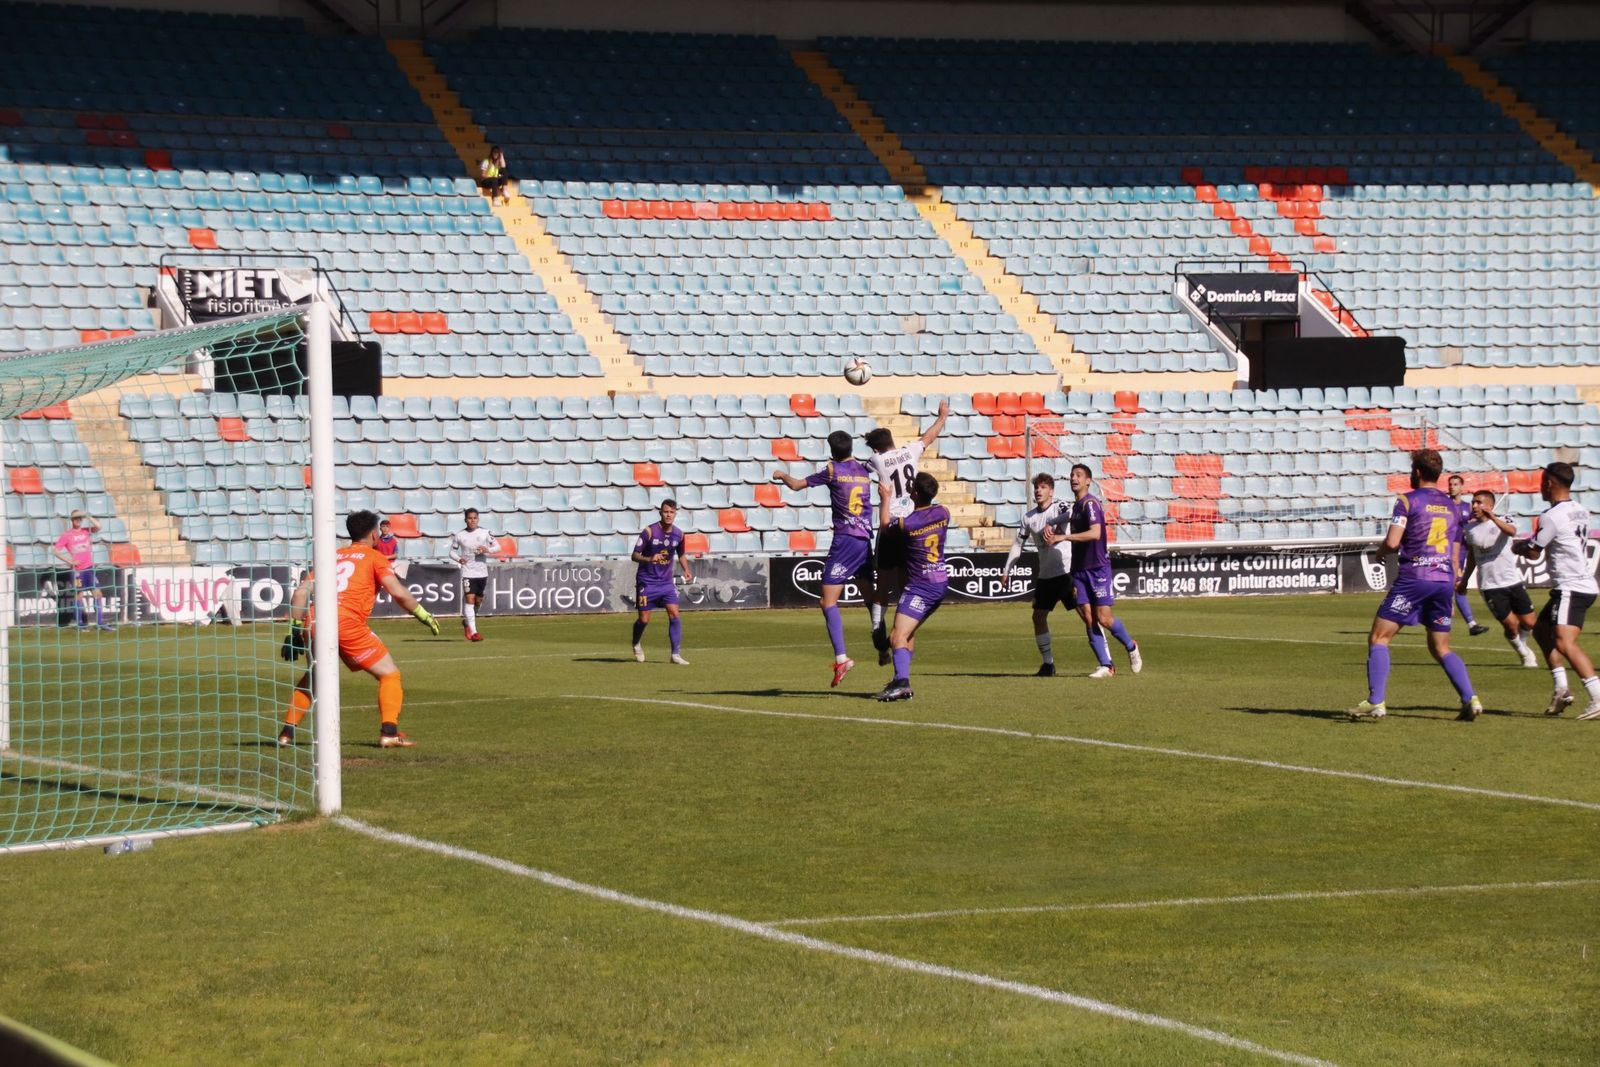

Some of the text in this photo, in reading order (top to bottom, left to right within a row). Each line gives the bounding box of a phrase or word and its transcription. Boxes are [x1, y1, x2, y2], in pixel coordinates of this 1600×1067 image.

[1207, 290, 1296, 302] Domino's Pizza
[890, 463, 916, 499] 18
[849, 486, 863, 516] 6
[924, 533, 940, 563] 3
[1426, 517, 1449, 554] 4
[1137, 552, 1337, 578] Tu pintor de confianza
[493, 577, 605, 610] Herrero
[966, 577, 982, 593] el
[1147, 578, 1169, 593] 658
[1172, 577, 1196, 593] 246
[1228, 573, 1337, 592] pinturasoche.es
